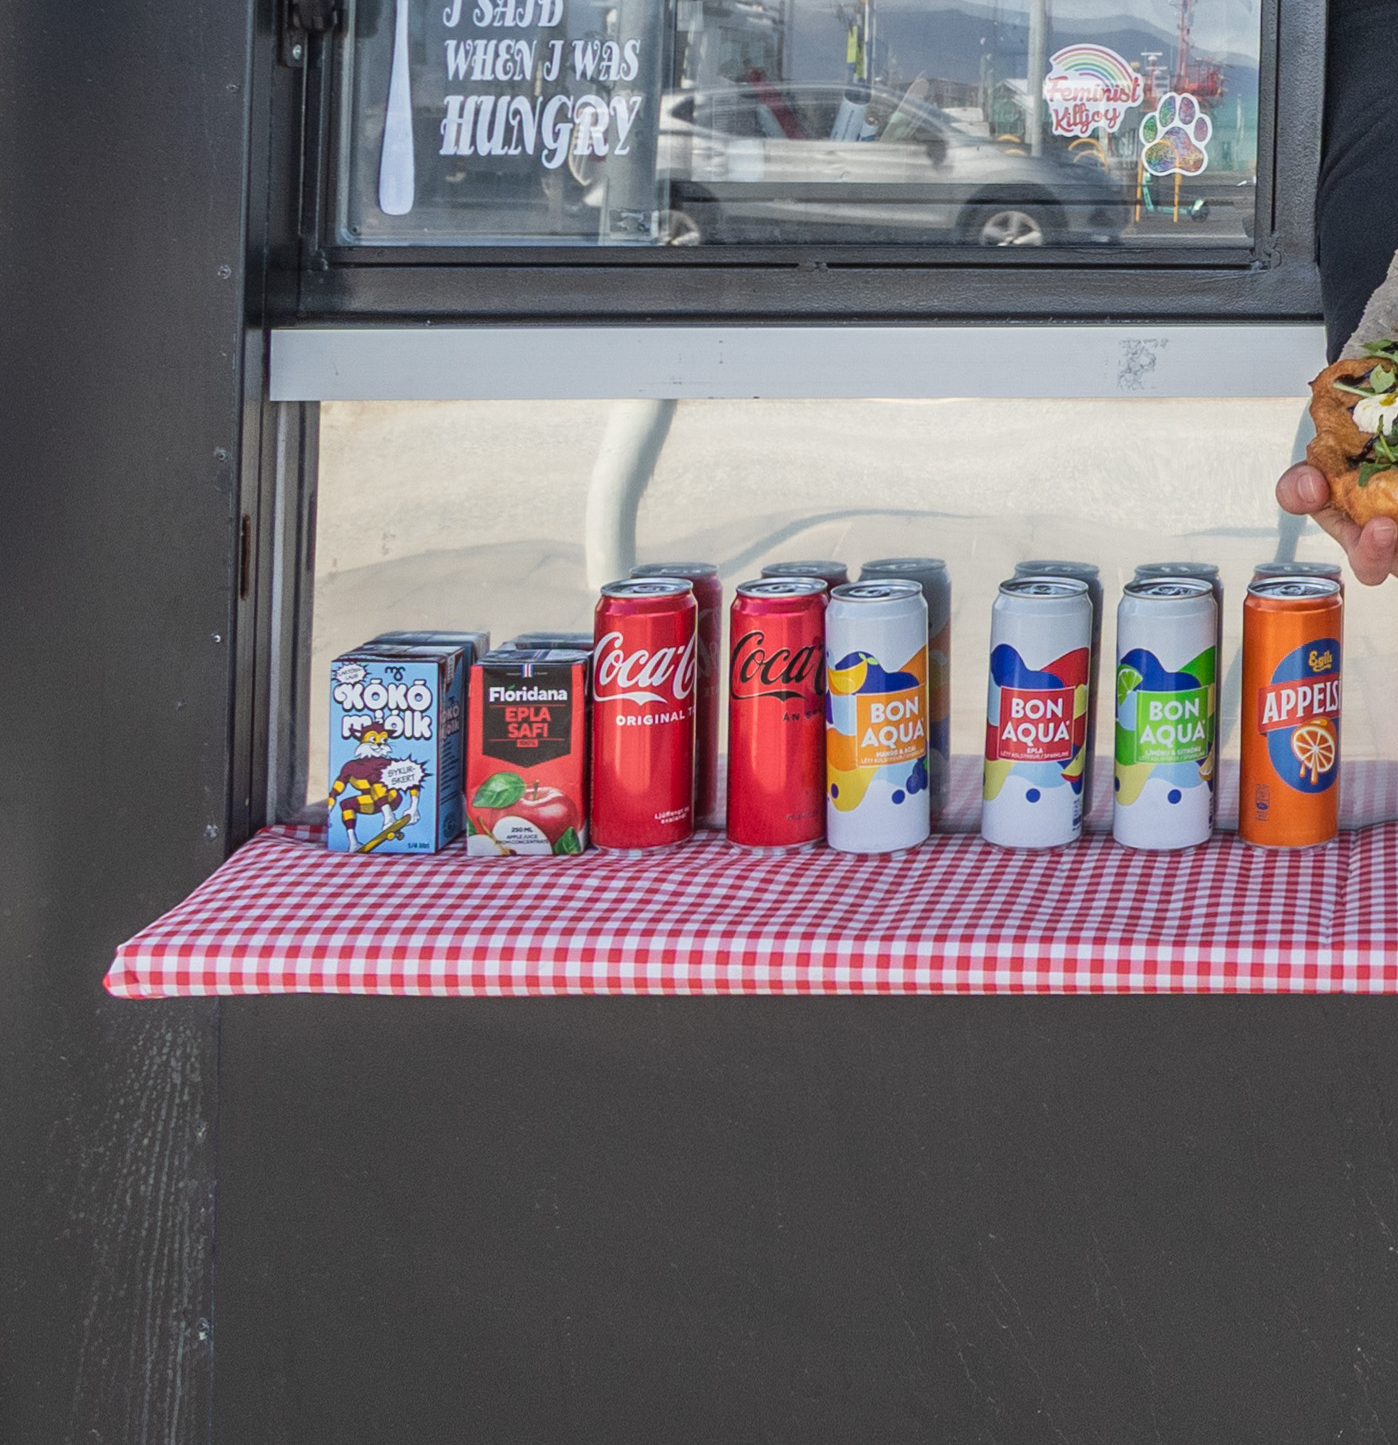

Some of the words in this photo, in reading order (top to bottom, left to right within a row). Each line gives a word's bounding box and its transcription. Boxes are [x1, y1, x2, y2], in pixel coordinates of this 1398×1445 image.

[445, 40, 537, 81] WHEN
[572, 39, 641, 81] WAS
[1047, 76, 1141, 103] Feminist
[440, 95, 642, 169] HUNGRY
[1053, 104, 1121, 135] Killjoy
[505, 707, 551, 722] EPLA
[871, 696, 919, 723] BON
[1011, 698, 1063, 720] BON
[1149, 698, 1199, 721] BON
[1262, 681, 1340, 724] APPELS
[508, 723, 548, 738] SAFI
[615, 710, 685, 726] ORIGINAL
[861, 719, 924, 748] AQUA
[1001, 721, 1069, 747] AQUA
[1140, 720, 1205, 748] AQUA
